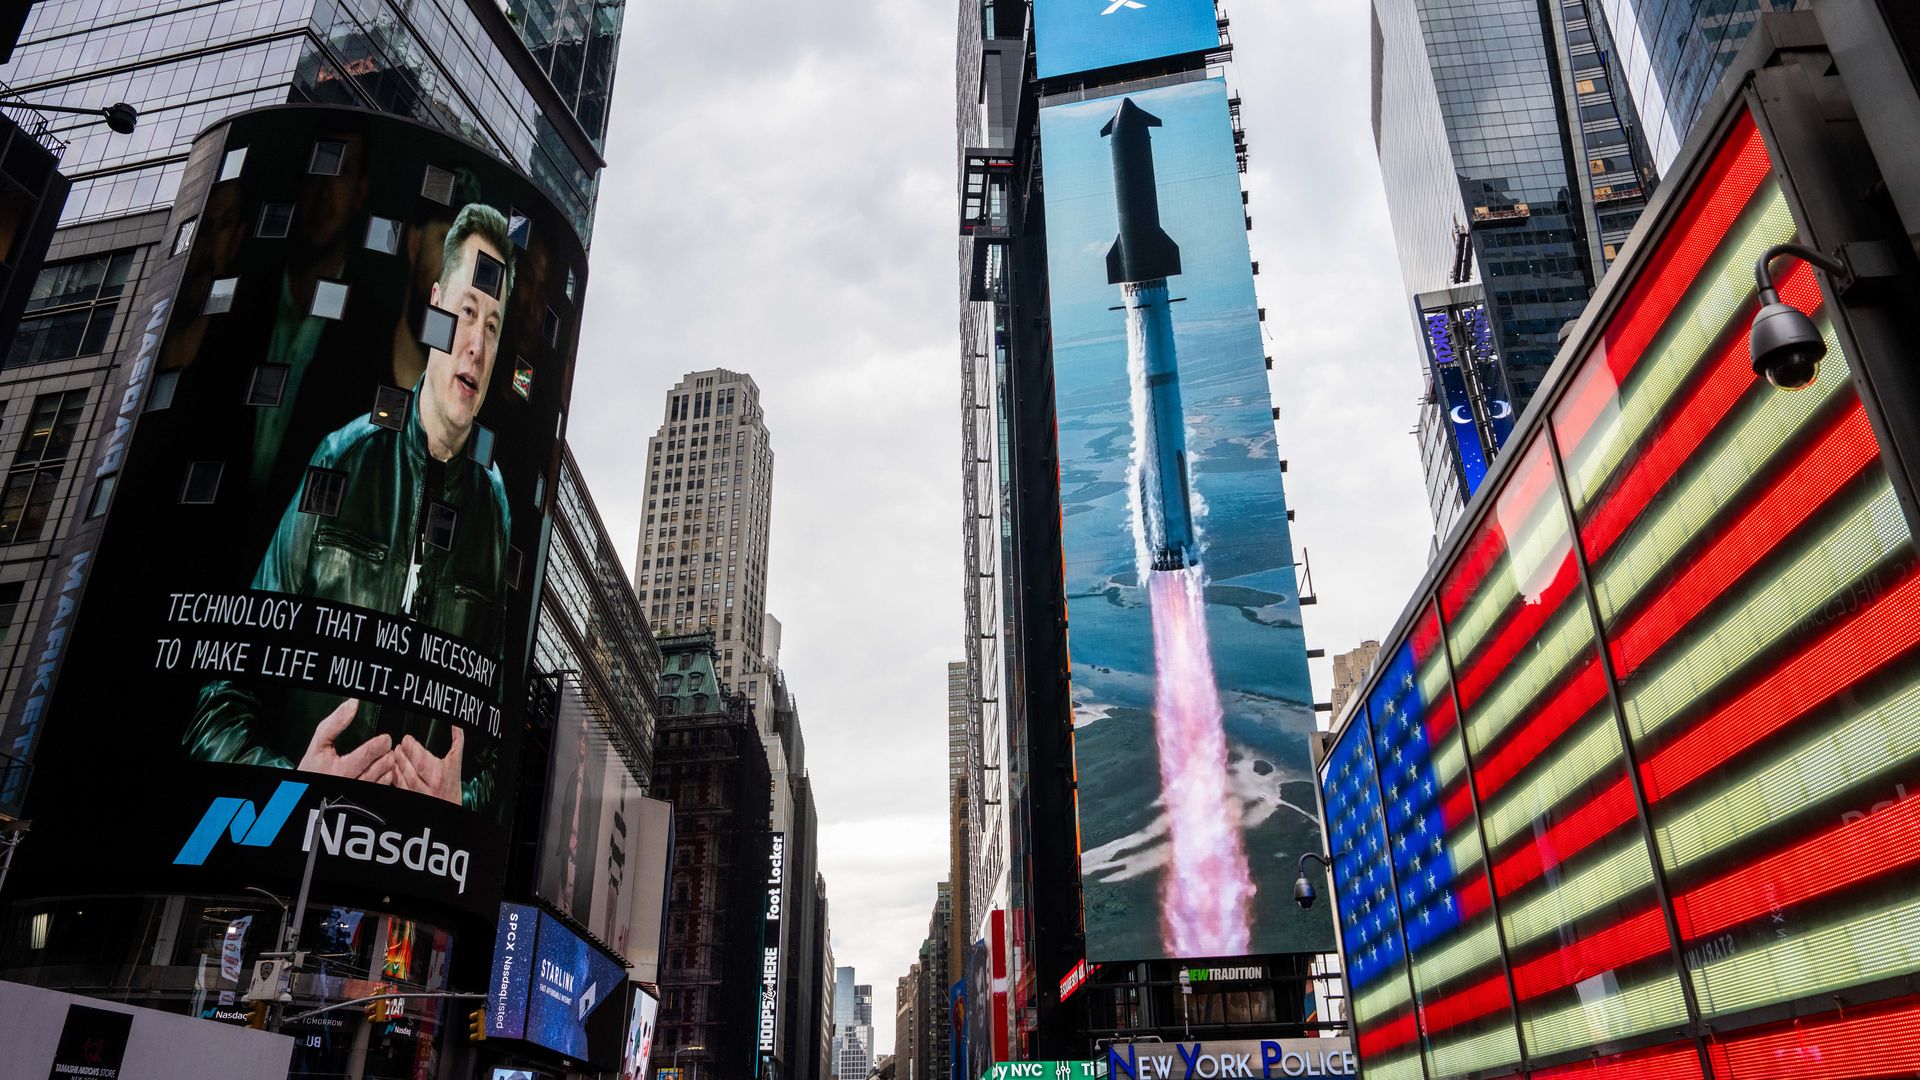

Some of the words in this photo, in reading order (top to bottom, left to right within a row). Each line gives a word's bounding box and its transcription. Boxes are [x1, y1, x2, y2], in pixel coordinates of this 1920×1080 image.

[168, 592, 303, 631] TECHNOLOGY
[315, 606, 367, 642] THAT
[375, 619, 412, 655] WAS
[419, 632, 497, 688] NECESSARY
[155, 638, 182, 670] TO
[190, 640, 251, 672] MAKE
[261, 645, 319, 681] LIFE
[327, 655, 485, 727] MULTI-PLANETARY
[302, 808, 470, 895] Nasdaq
[766, 887, 781, 921] Foot
[505, 913, 519, 951] SPCX
[540, 958, 575, 993] STARLINK
[763, 947, 778, 984] HERE
[394, 1025, 411, 1037] Nasdaq
[759, 999, 775, 1051] HOOPS
[100, 1069, 116, 1079] STORE
[1011, 1063, 1043, 1077] NYC
[1260, 1040, 1356, 1079] POLICE
